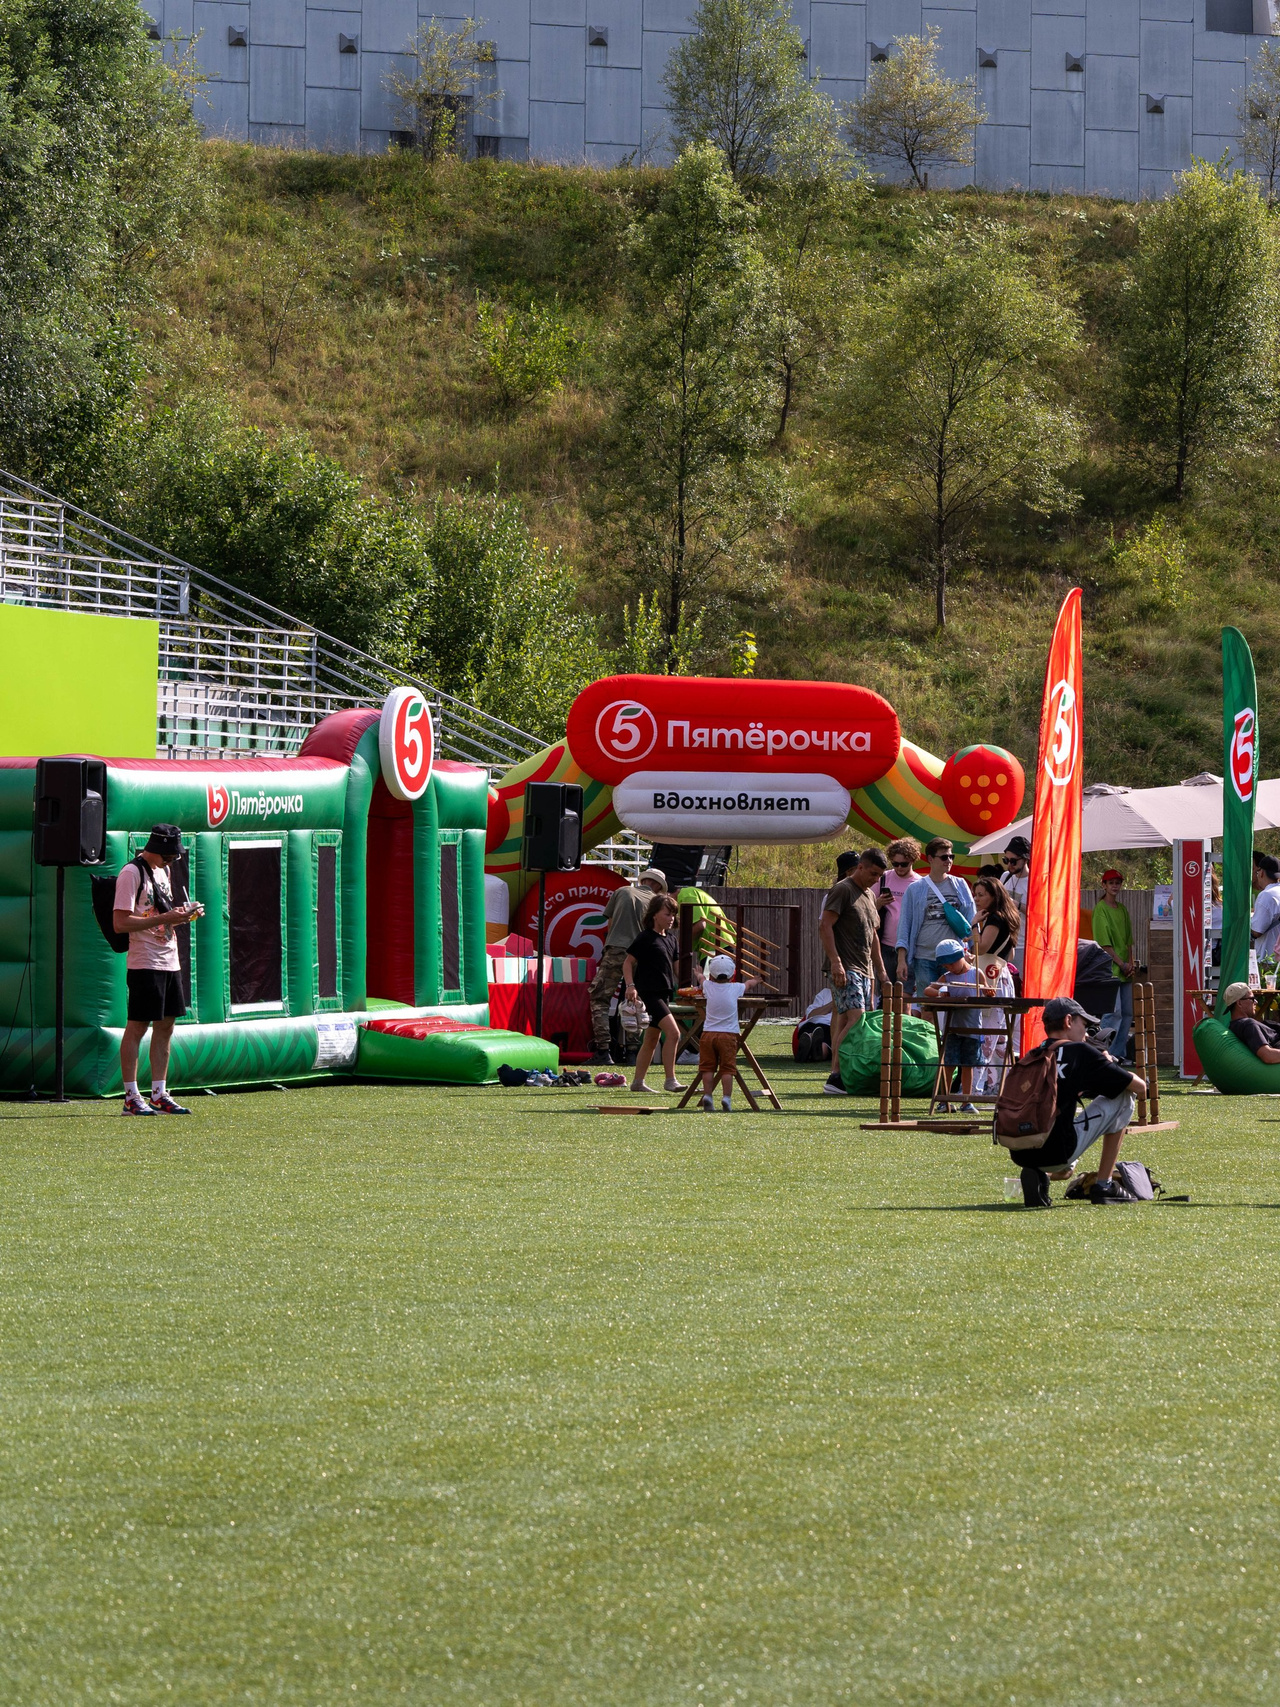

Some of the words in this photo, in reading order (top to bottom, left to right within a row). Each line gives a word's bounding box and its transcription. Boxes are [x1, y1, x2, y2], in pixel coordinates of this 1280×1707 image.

[667, 720, 871, 756] Пятёрочка
[231, 790, 303, 820] Пятёрочка
[653, 792, 810, 811] Вдохновляет
[528, 892, 565, 931] Мсто
